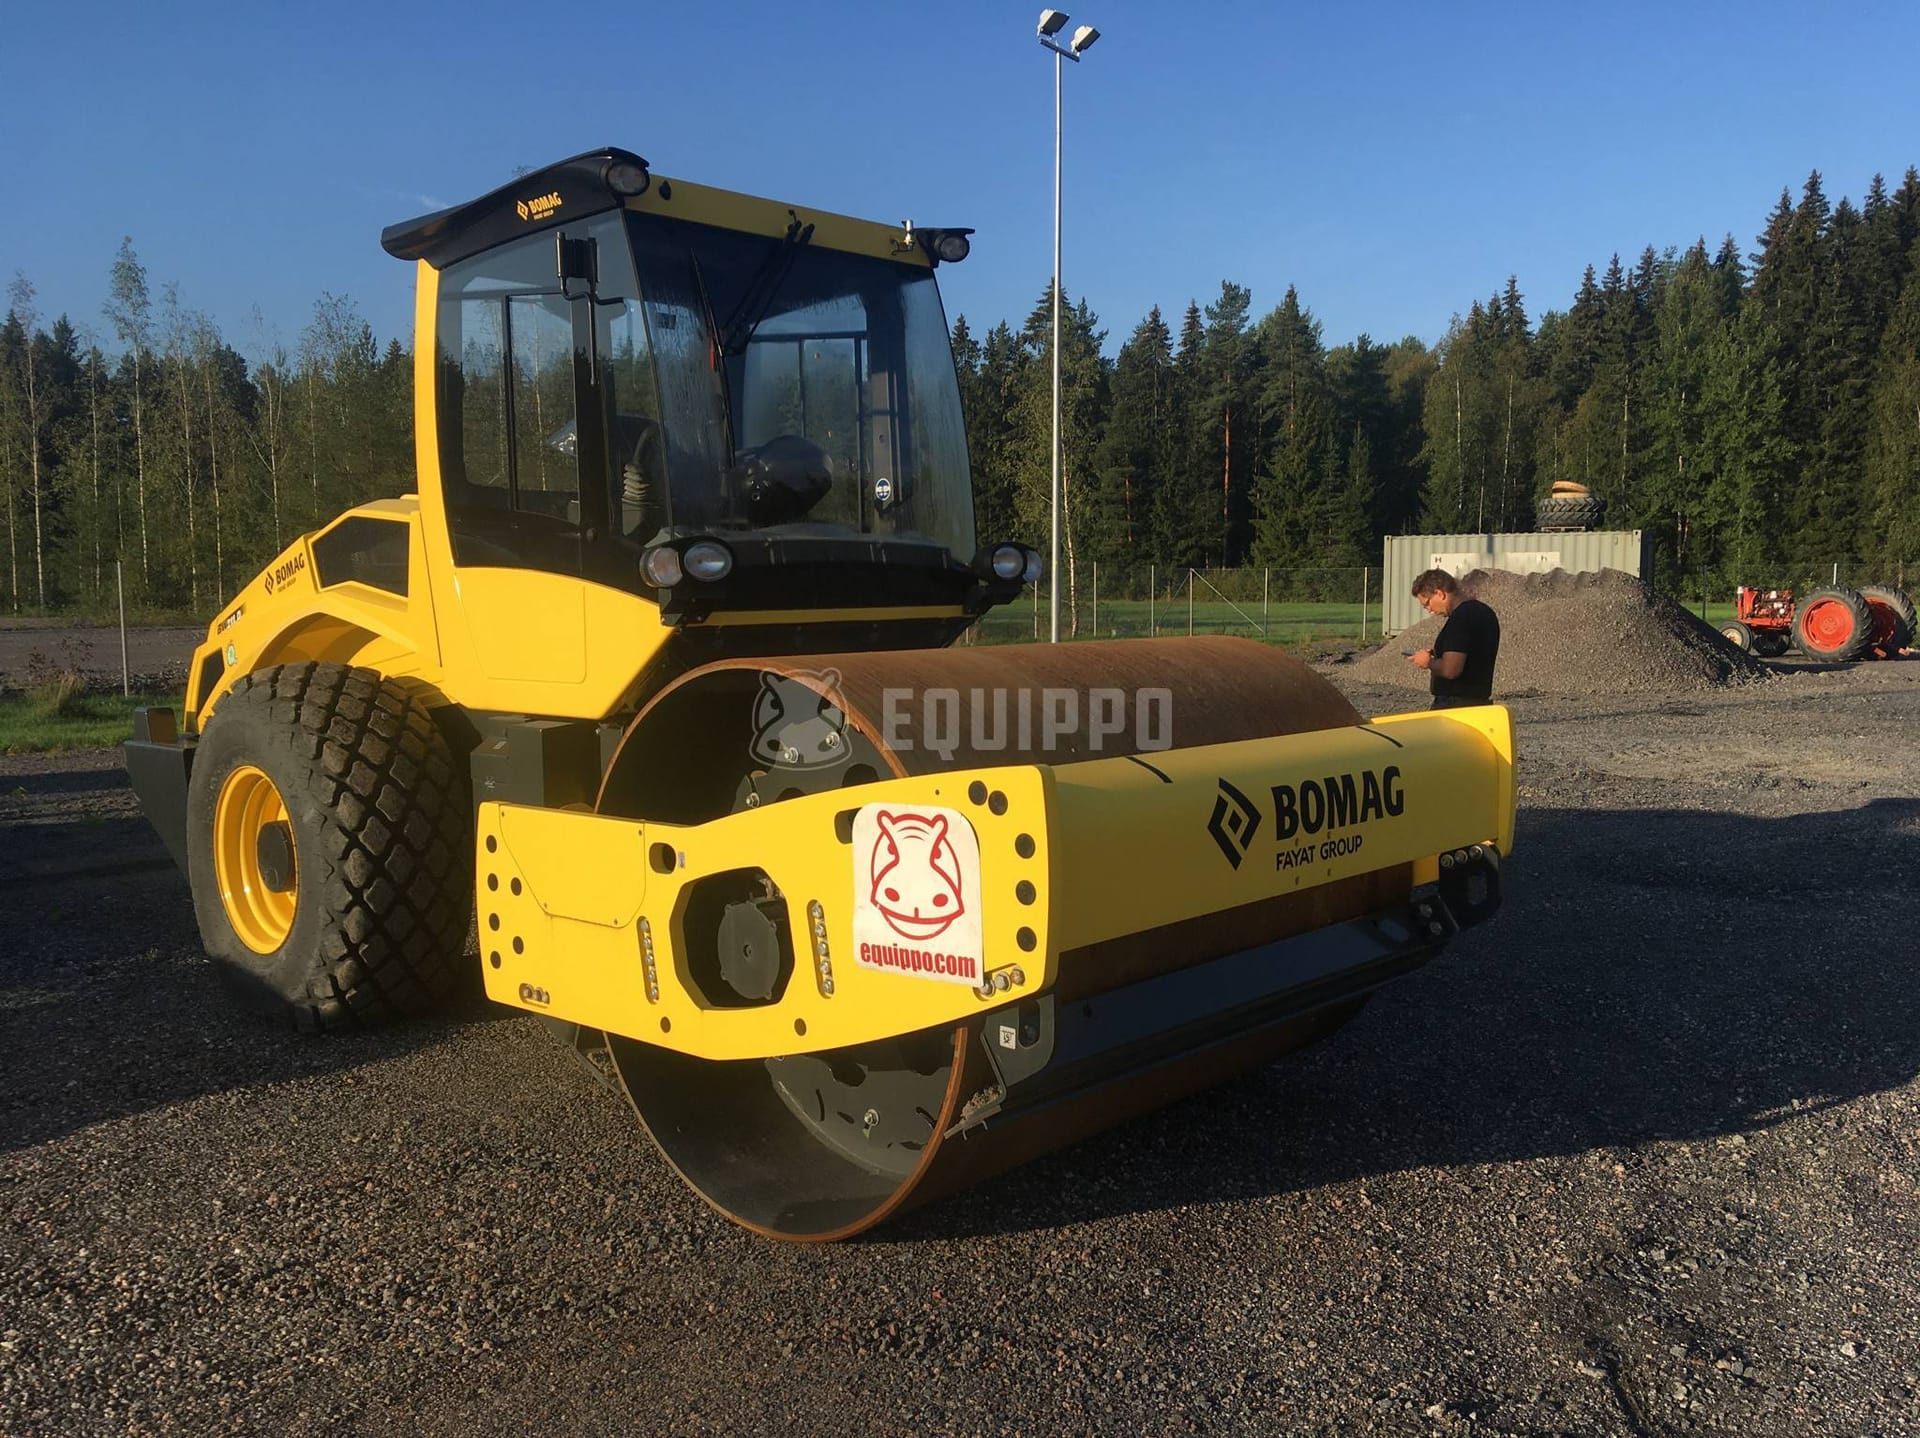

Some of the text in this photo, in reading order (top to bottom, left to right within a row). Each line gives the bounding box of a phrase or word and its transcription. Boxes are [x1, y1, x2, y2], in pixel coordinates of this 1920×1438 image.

[528, 192, 562, 213] BOMAG
[276, 552, 304, 585] BOMAG
[1271, 765, 1404, 841] BOMAG
[1276, 834, 1363, 871] FAYAT GROUP
[860, 942, 976, 979] equippo.com
